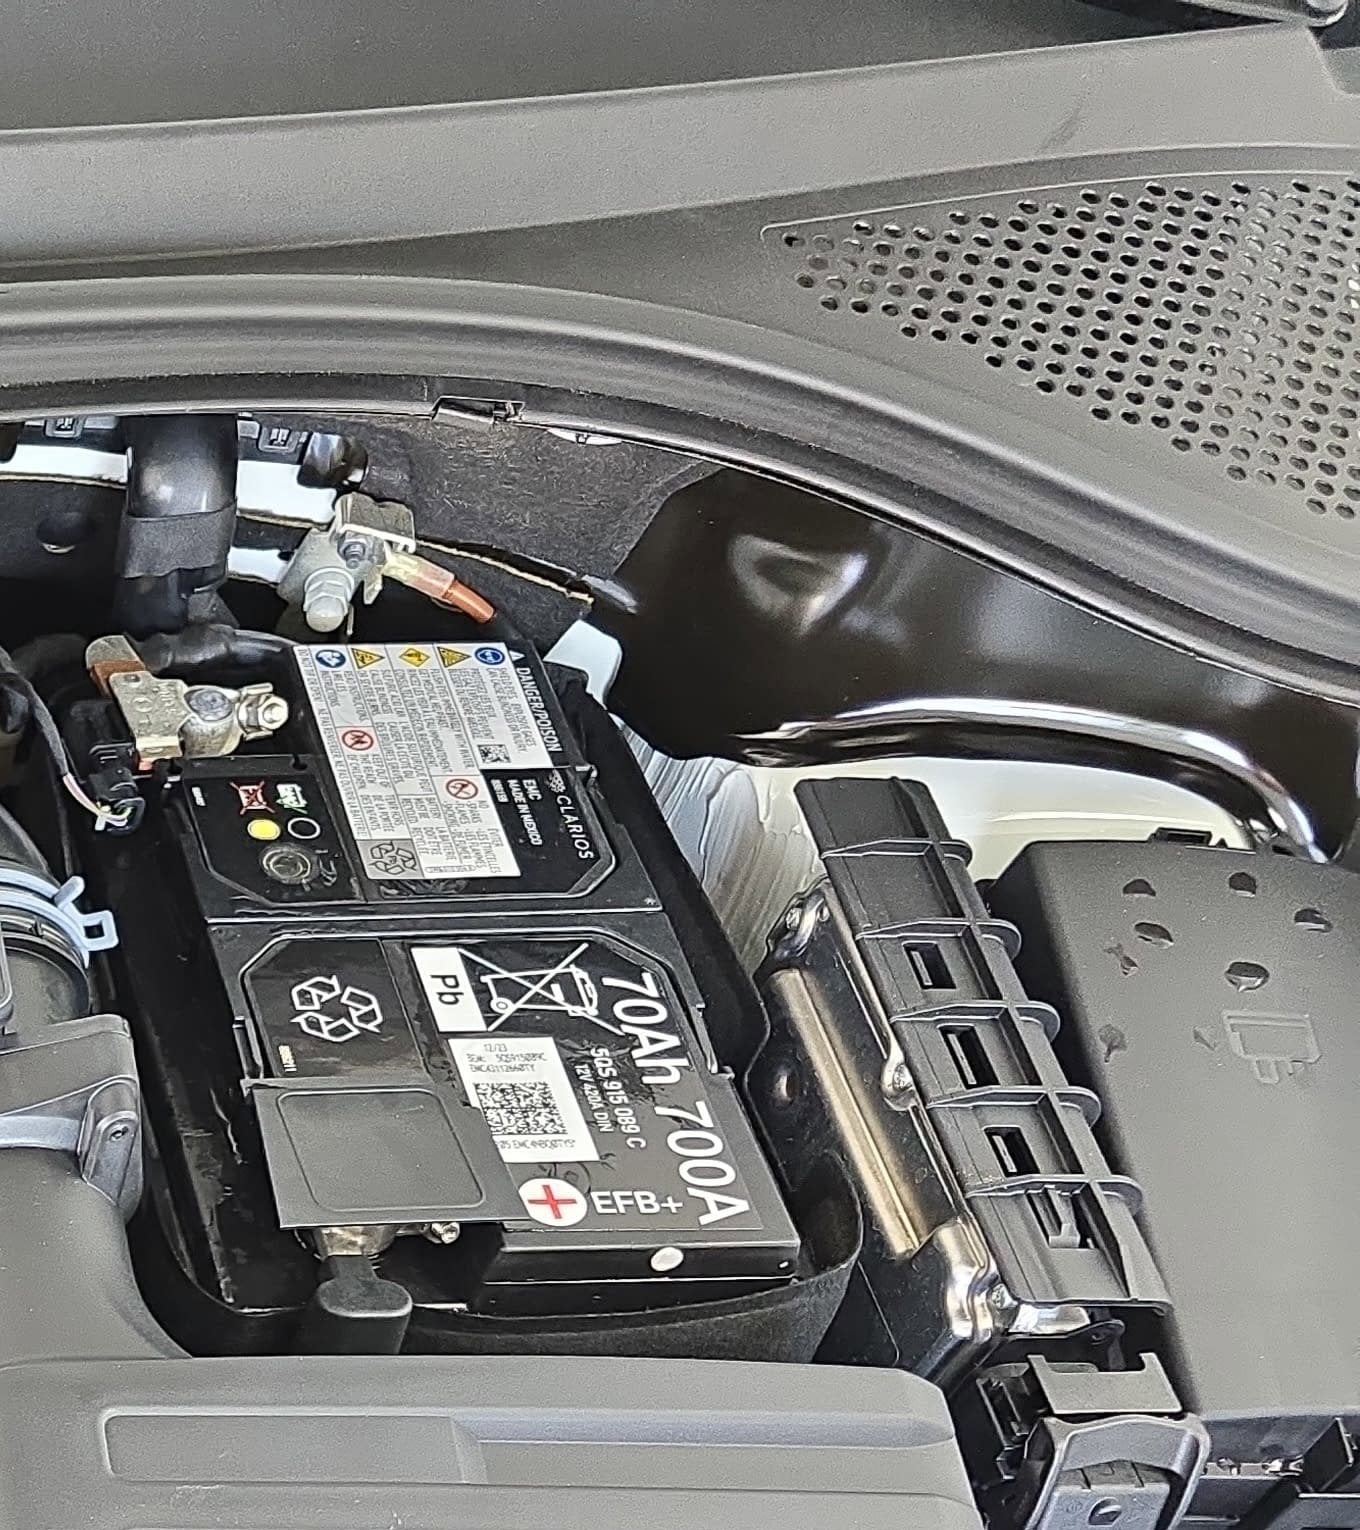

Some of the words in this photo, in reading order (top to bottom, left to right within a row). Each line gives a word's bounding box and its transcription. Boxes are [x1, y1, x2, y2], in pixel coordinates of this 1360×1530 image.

[516, 667, 562, 752] DANGER/POISON
[507, 779, 526, 804] MADE
[522, 779, 542, 800] EMC
[517, 803, 530, 814] IN
[521, 814, 543, 845] MEXICO
[557, 795, 594, 859] CLARIOS
[430, 974, 465, 1006] Pb
[574, 1064, 591, 1083] 12V
[590, 1048, 613, 1078] 5QS
[582, 1083, 603, 1112] 420A
[602, 973, 689, 1084] 70Ah
[655, 1101, 750, 1225] 700A
[605, 1080, 629, 1105] 915
[593, 1112, 614, 1132] DIN
[614, 1108, 641, 1136] 089
[626, 1137, 646, 1149] C
[589, 1191, 683, 1215] EFB+
